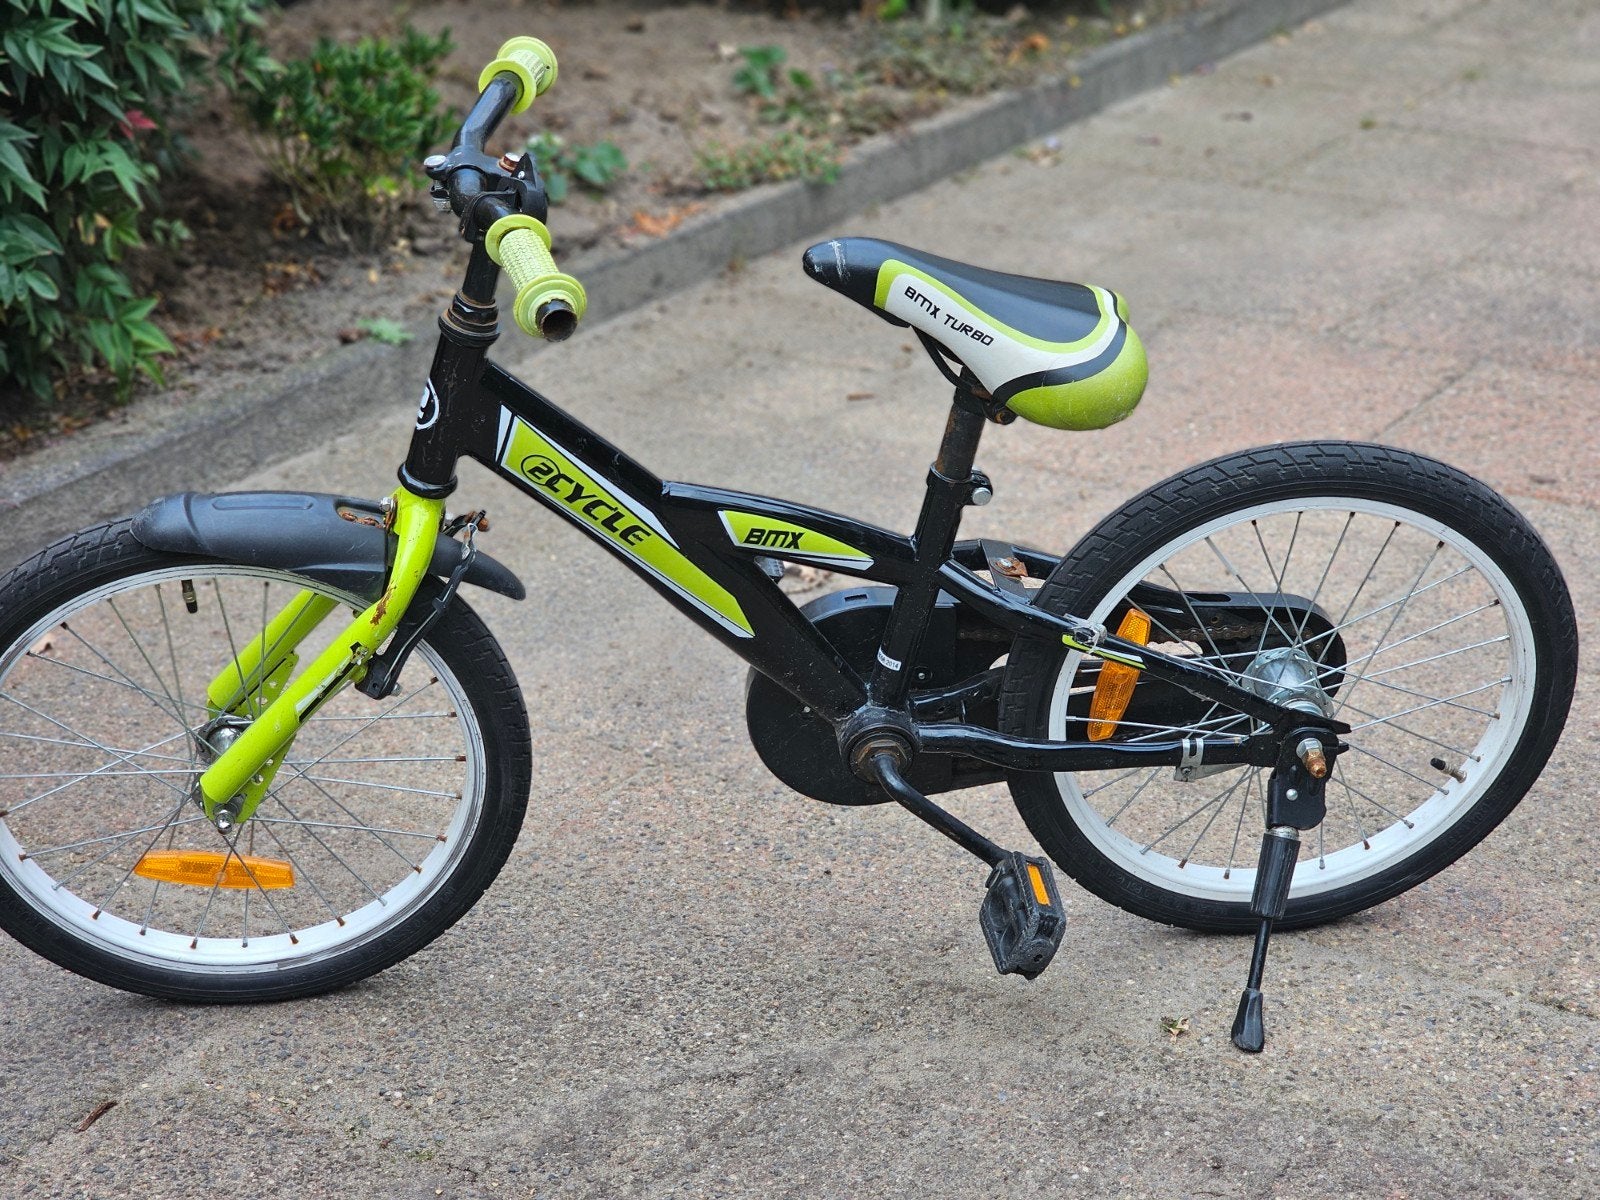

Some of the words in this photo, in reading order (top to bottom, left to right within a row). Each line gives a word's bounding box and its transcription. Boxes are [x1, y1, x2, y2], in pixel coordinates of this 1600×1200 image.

[904, 286, 941, 319] BMX
[943, 313, 995, 346] TURBO
[742, 528, 806, 549] BMX
